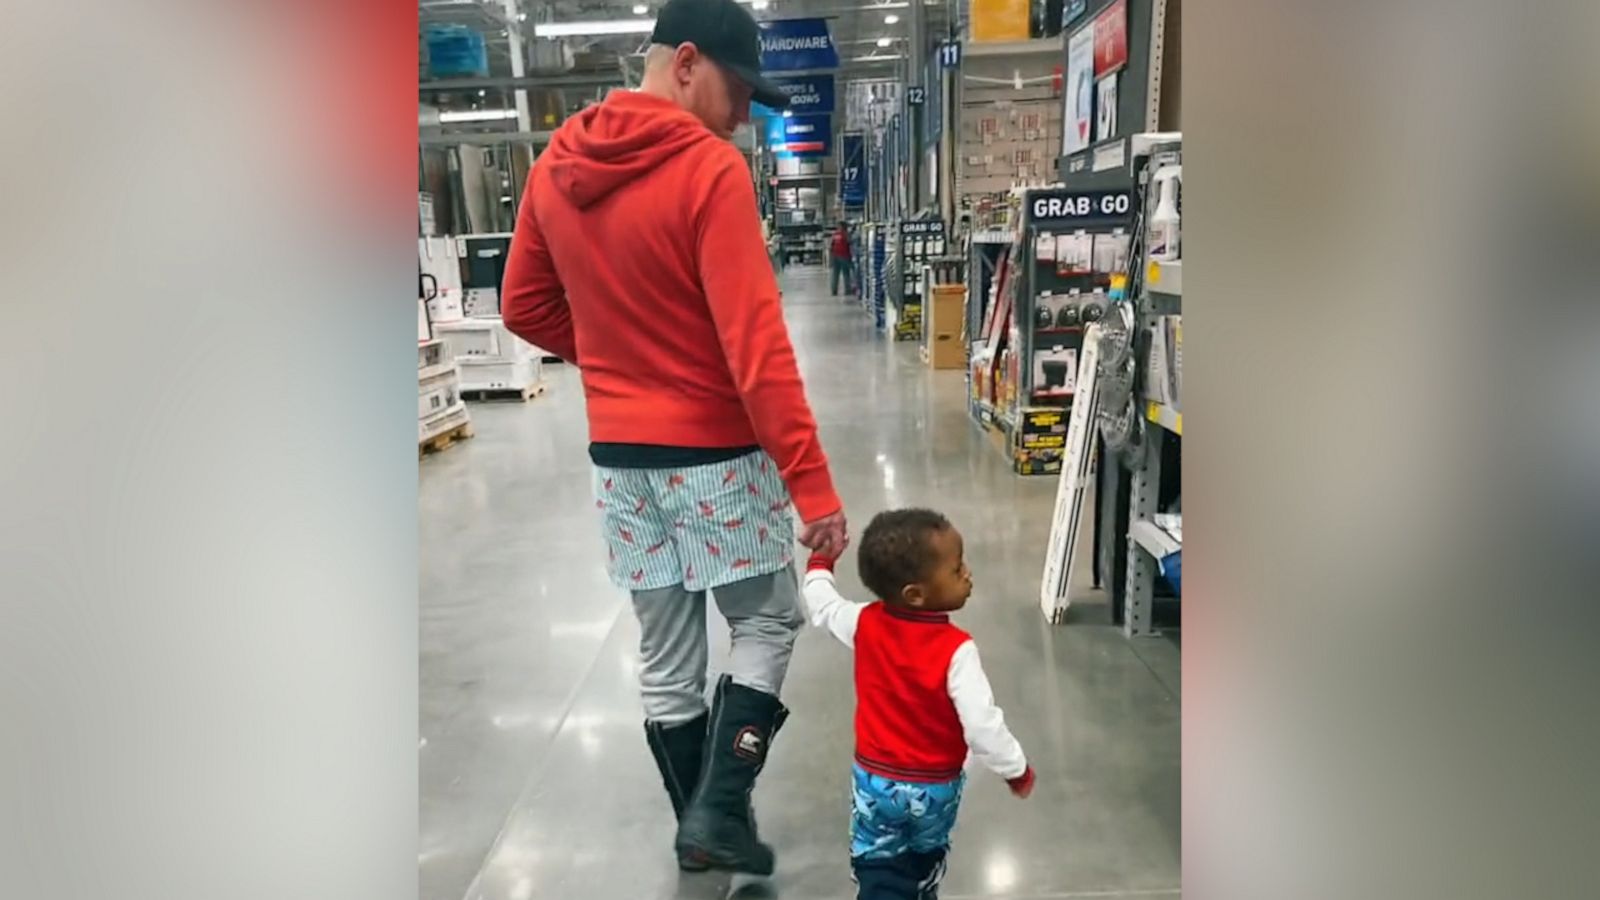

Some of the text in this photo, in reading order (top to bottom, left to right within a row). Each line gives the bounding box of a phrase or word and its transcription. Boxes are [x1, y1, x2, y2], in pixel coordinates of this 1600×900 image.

[760, 36, 828, 51] HARDWARE
[943, 45, 957, 65] 11
[909, 89, 923, 103] 12
[844, 167, 858, 180] 17
[1033, 197, 1090, 218] GRAB
[1100, 194, 1129, 214] GO
